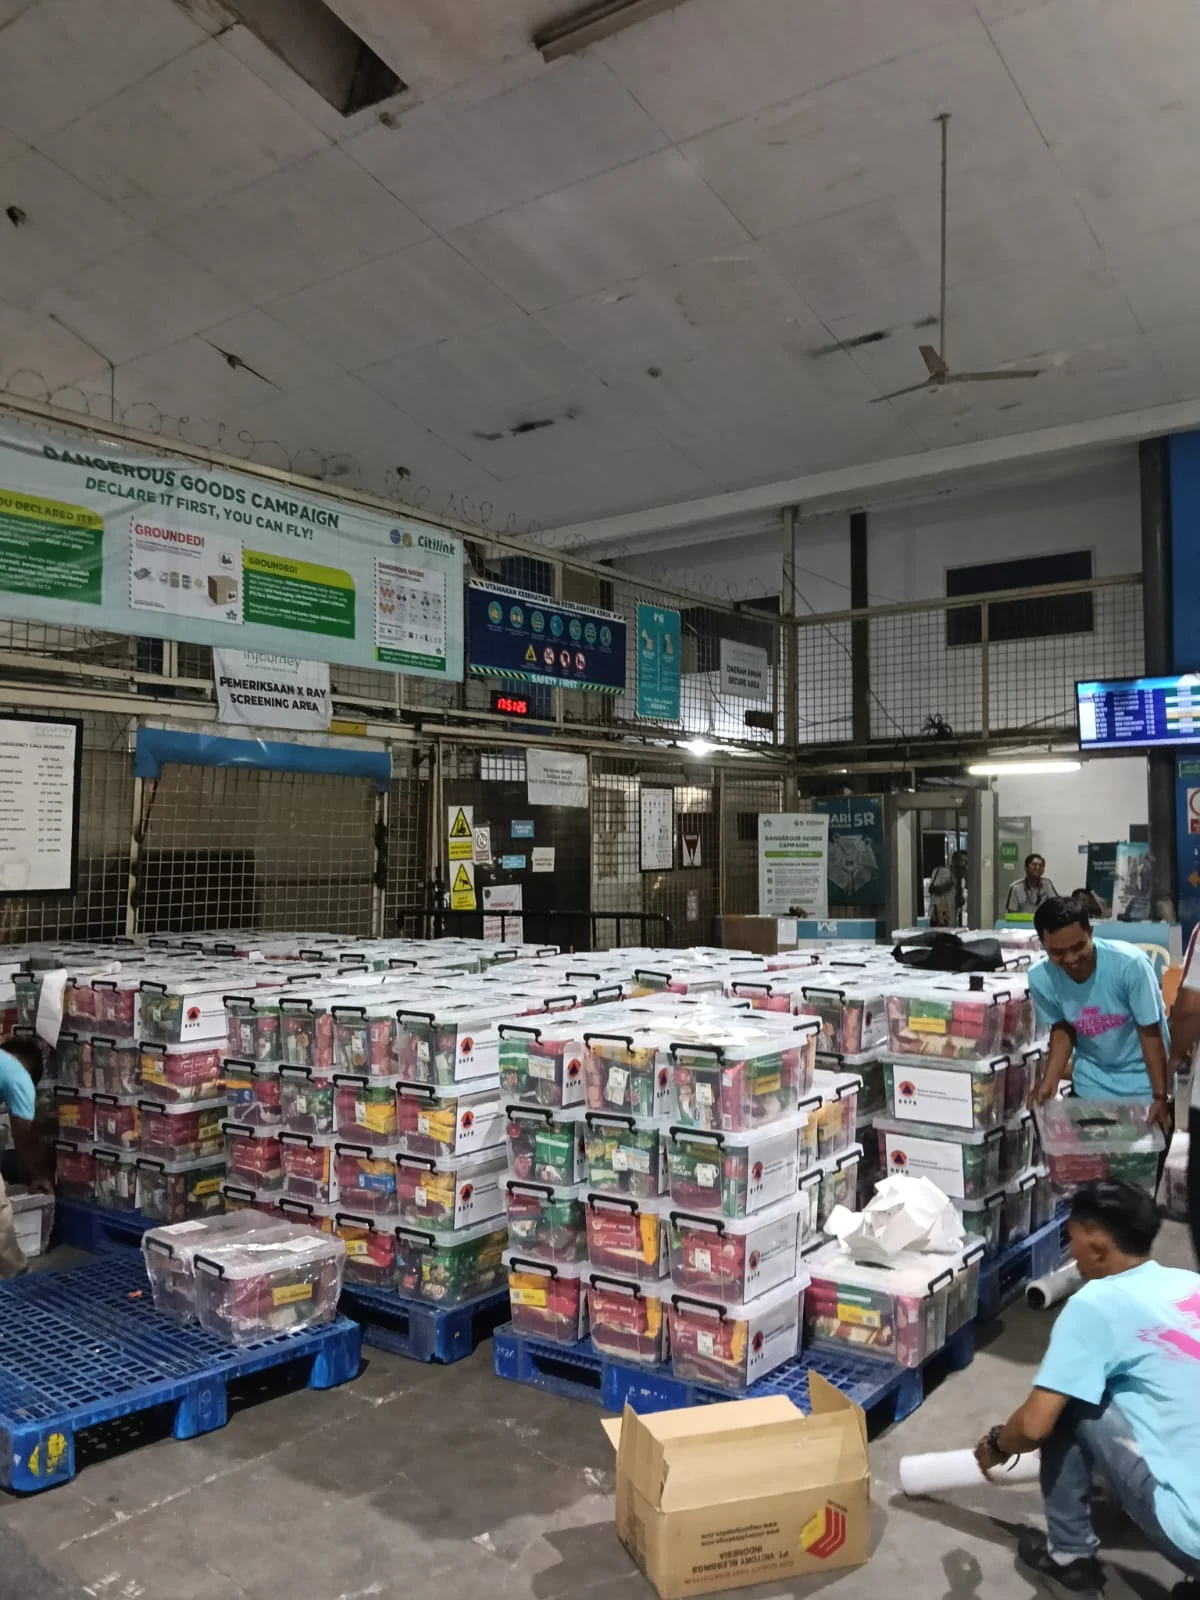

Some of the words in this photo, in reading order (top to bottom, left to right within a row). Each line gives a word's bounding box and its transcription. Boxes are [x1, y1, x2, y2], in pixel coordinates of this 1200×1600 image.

[43, 446, 176, 487] DANGEROUS
[180, 474, 246, 504] GOODS
[251, 492, 339, 529] CAMPAIGN
[15, 500, 74, 520] DECLARED
[85, 477, 157, 503] DECLARE
[160, 493, 174, 506] IT
[176, 497, 220, 520] FIRST,
[223, 508, 252, 525] YOU
[256, 516, 283, 533] CAN
[286, 524, 313, 540] FLY!
[134, 523, 205, 548] GROUNDED!
[417, 535, 456, 556] Citilink
[219, 676, 295, 695] PEMERIKSAAN
[297, 686, 305, 697] X
[306, 687, 326, 698] RAY
[531, 673, 557, 685] SAFETY
[230, 693, 289, 709] SCREENING
[292, 700, 320, 712] AREA
[719, 1545, 763, 1560] INDONESIA
[741, 1552, 775, 1565] VICTORY
